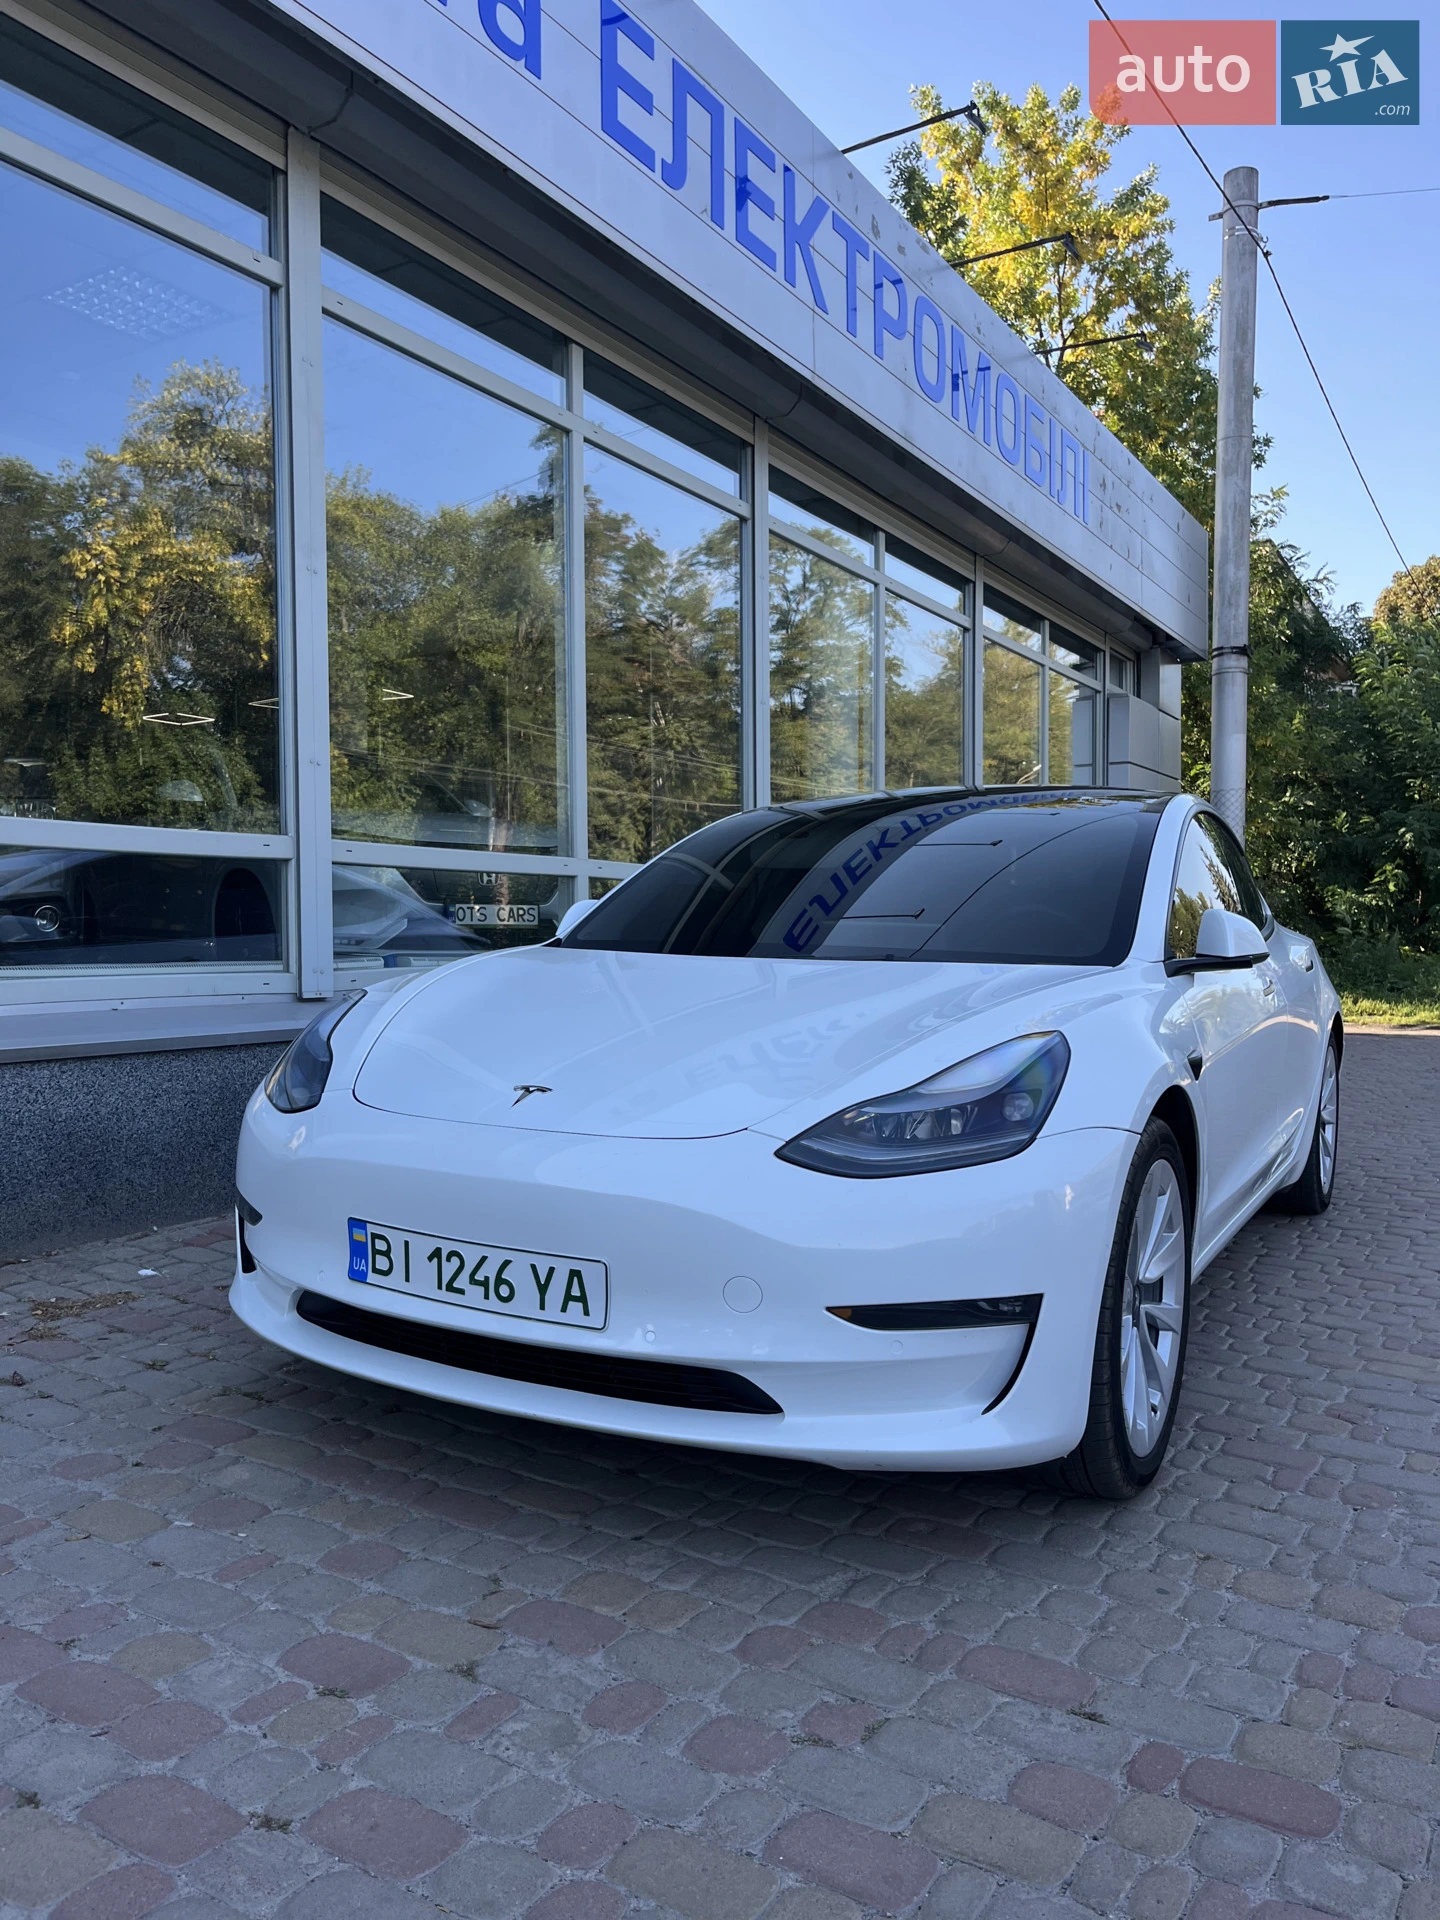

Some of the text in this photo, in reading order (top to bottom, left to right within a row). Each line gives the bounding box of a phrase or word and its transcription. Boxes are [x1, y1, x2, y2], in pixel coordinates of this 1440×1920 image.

[600, 0, 1091, 525] ЕЛЕКТРОМОБІЛІ
[456, 906, 536, 923] OTS CARS
[353, 1231, 590, 1317] UA BI 1246 YA
